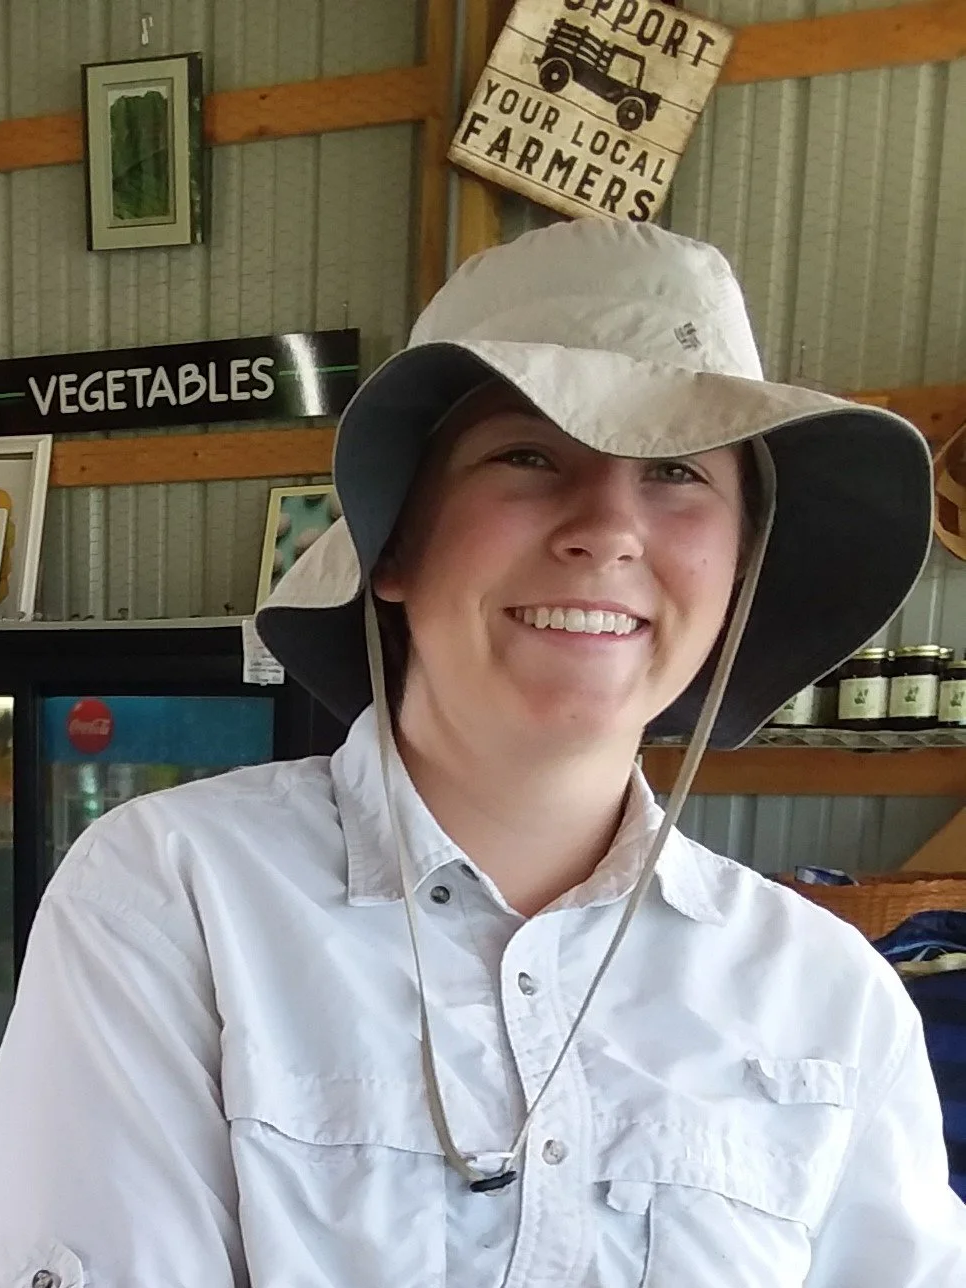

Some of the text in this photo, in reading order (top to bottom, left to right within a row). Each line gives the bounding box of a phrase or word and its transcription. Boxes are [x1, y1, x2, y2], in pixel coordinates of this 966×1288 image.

[563, 0, 715, 67] PPORT
[460, 111, 656, 222] FARMERS
[482, 79, 665, 186] YOUR LOCAL
[28, 356, 275, 416] VEGETABLES
